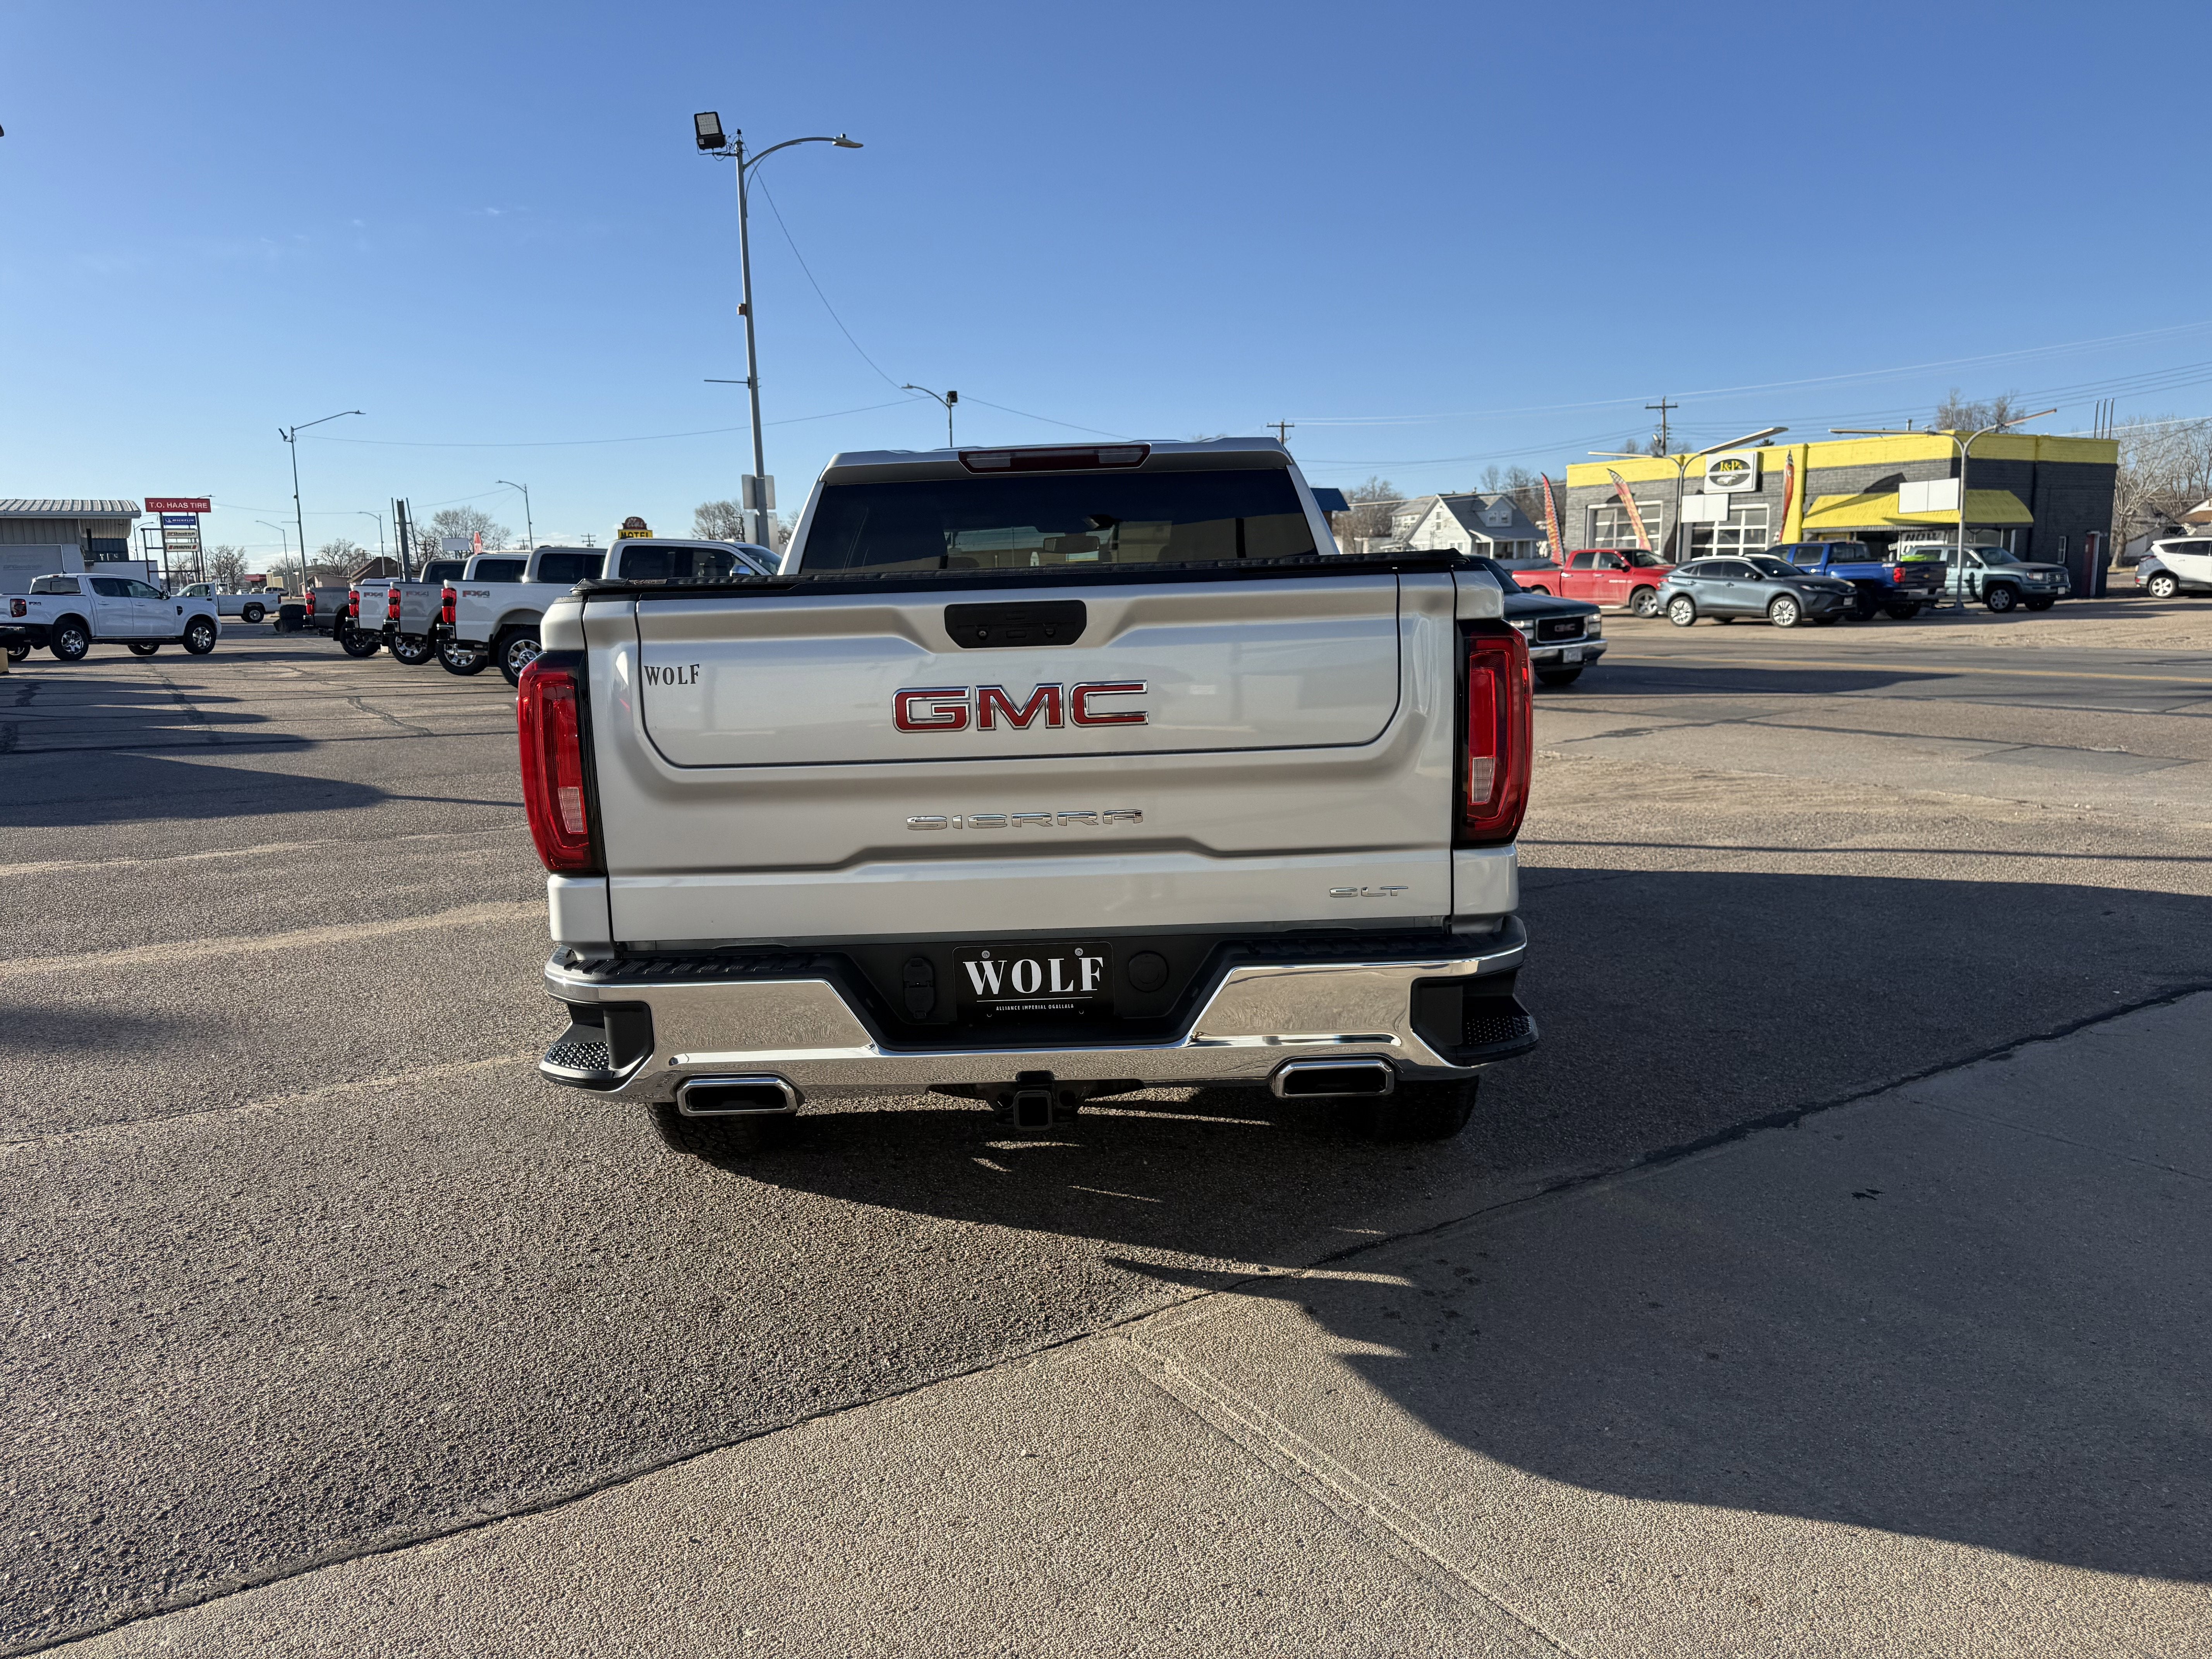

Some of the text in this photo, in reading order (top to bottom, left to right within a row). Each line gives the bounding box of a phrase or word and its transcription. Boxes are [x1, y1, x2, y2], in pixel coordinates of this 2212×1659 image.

[1906, 532, 1941, 541] NOW
[644, 664, 699, 686] WOLF
[892, 680, 1149, 733] GMC
[906, 809, 1144, 831] SIERRA
[1329, 886, 1408, 898] SLT
[962, 957, 1103, 995] WOLF
